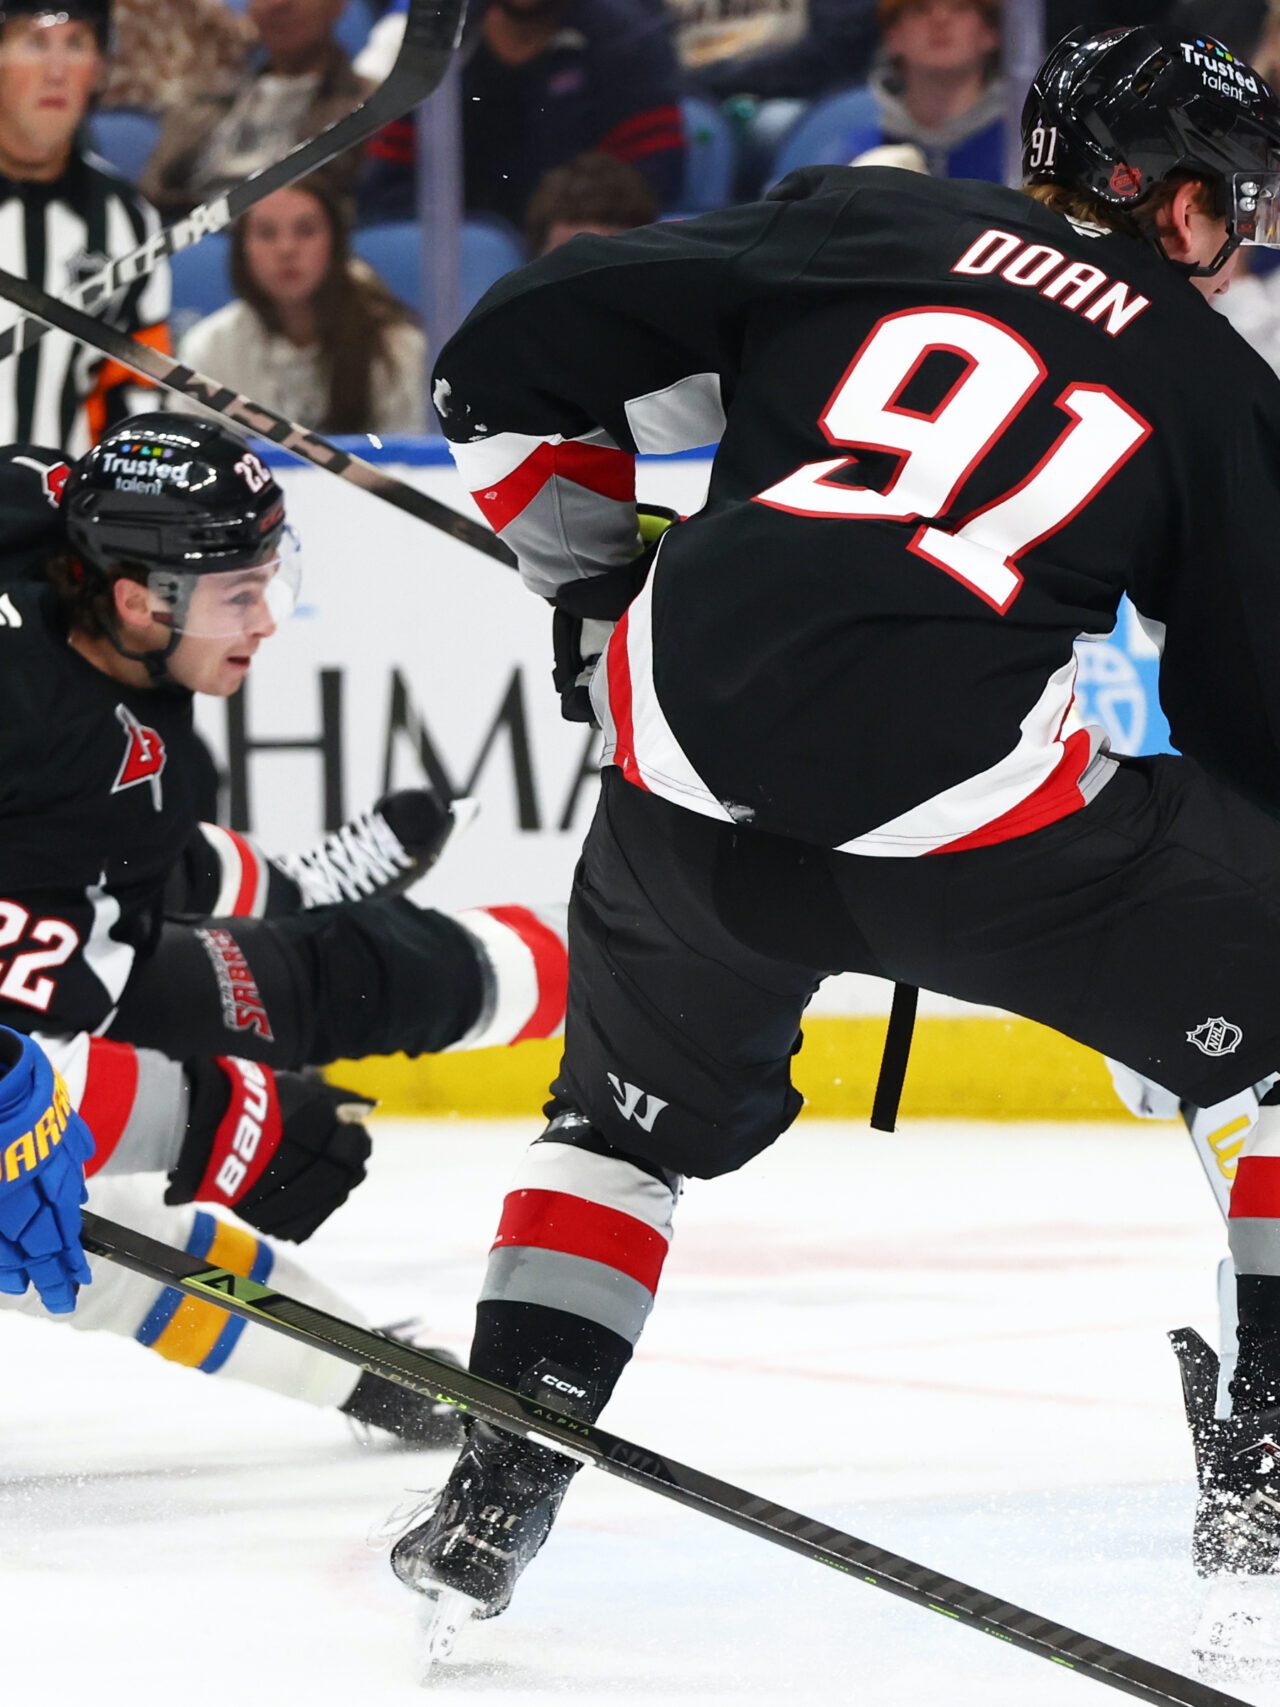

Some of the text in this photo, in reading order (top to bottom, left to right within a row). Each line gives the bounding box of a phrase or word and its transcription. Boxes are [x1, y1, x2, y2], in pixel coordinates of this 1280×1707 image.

[1180, 42, 1258, 95] Trusted
[1201, 70, 1244, 102] talent
[1029, 126, 1058, 168] 91
[952, 227, 1152, 338] DOAN
[102, 452, 193, 482] Trusted
[233, 452, 272, 494] 22
[755, 305, 1154, 617] 91
[115, 477, 163, 496] talent
[1208, 1026, 1225, 1050] NHL
[541, 1373, 588, 1399] CCM
[533, 1407, 590, 1436] ALPHA
